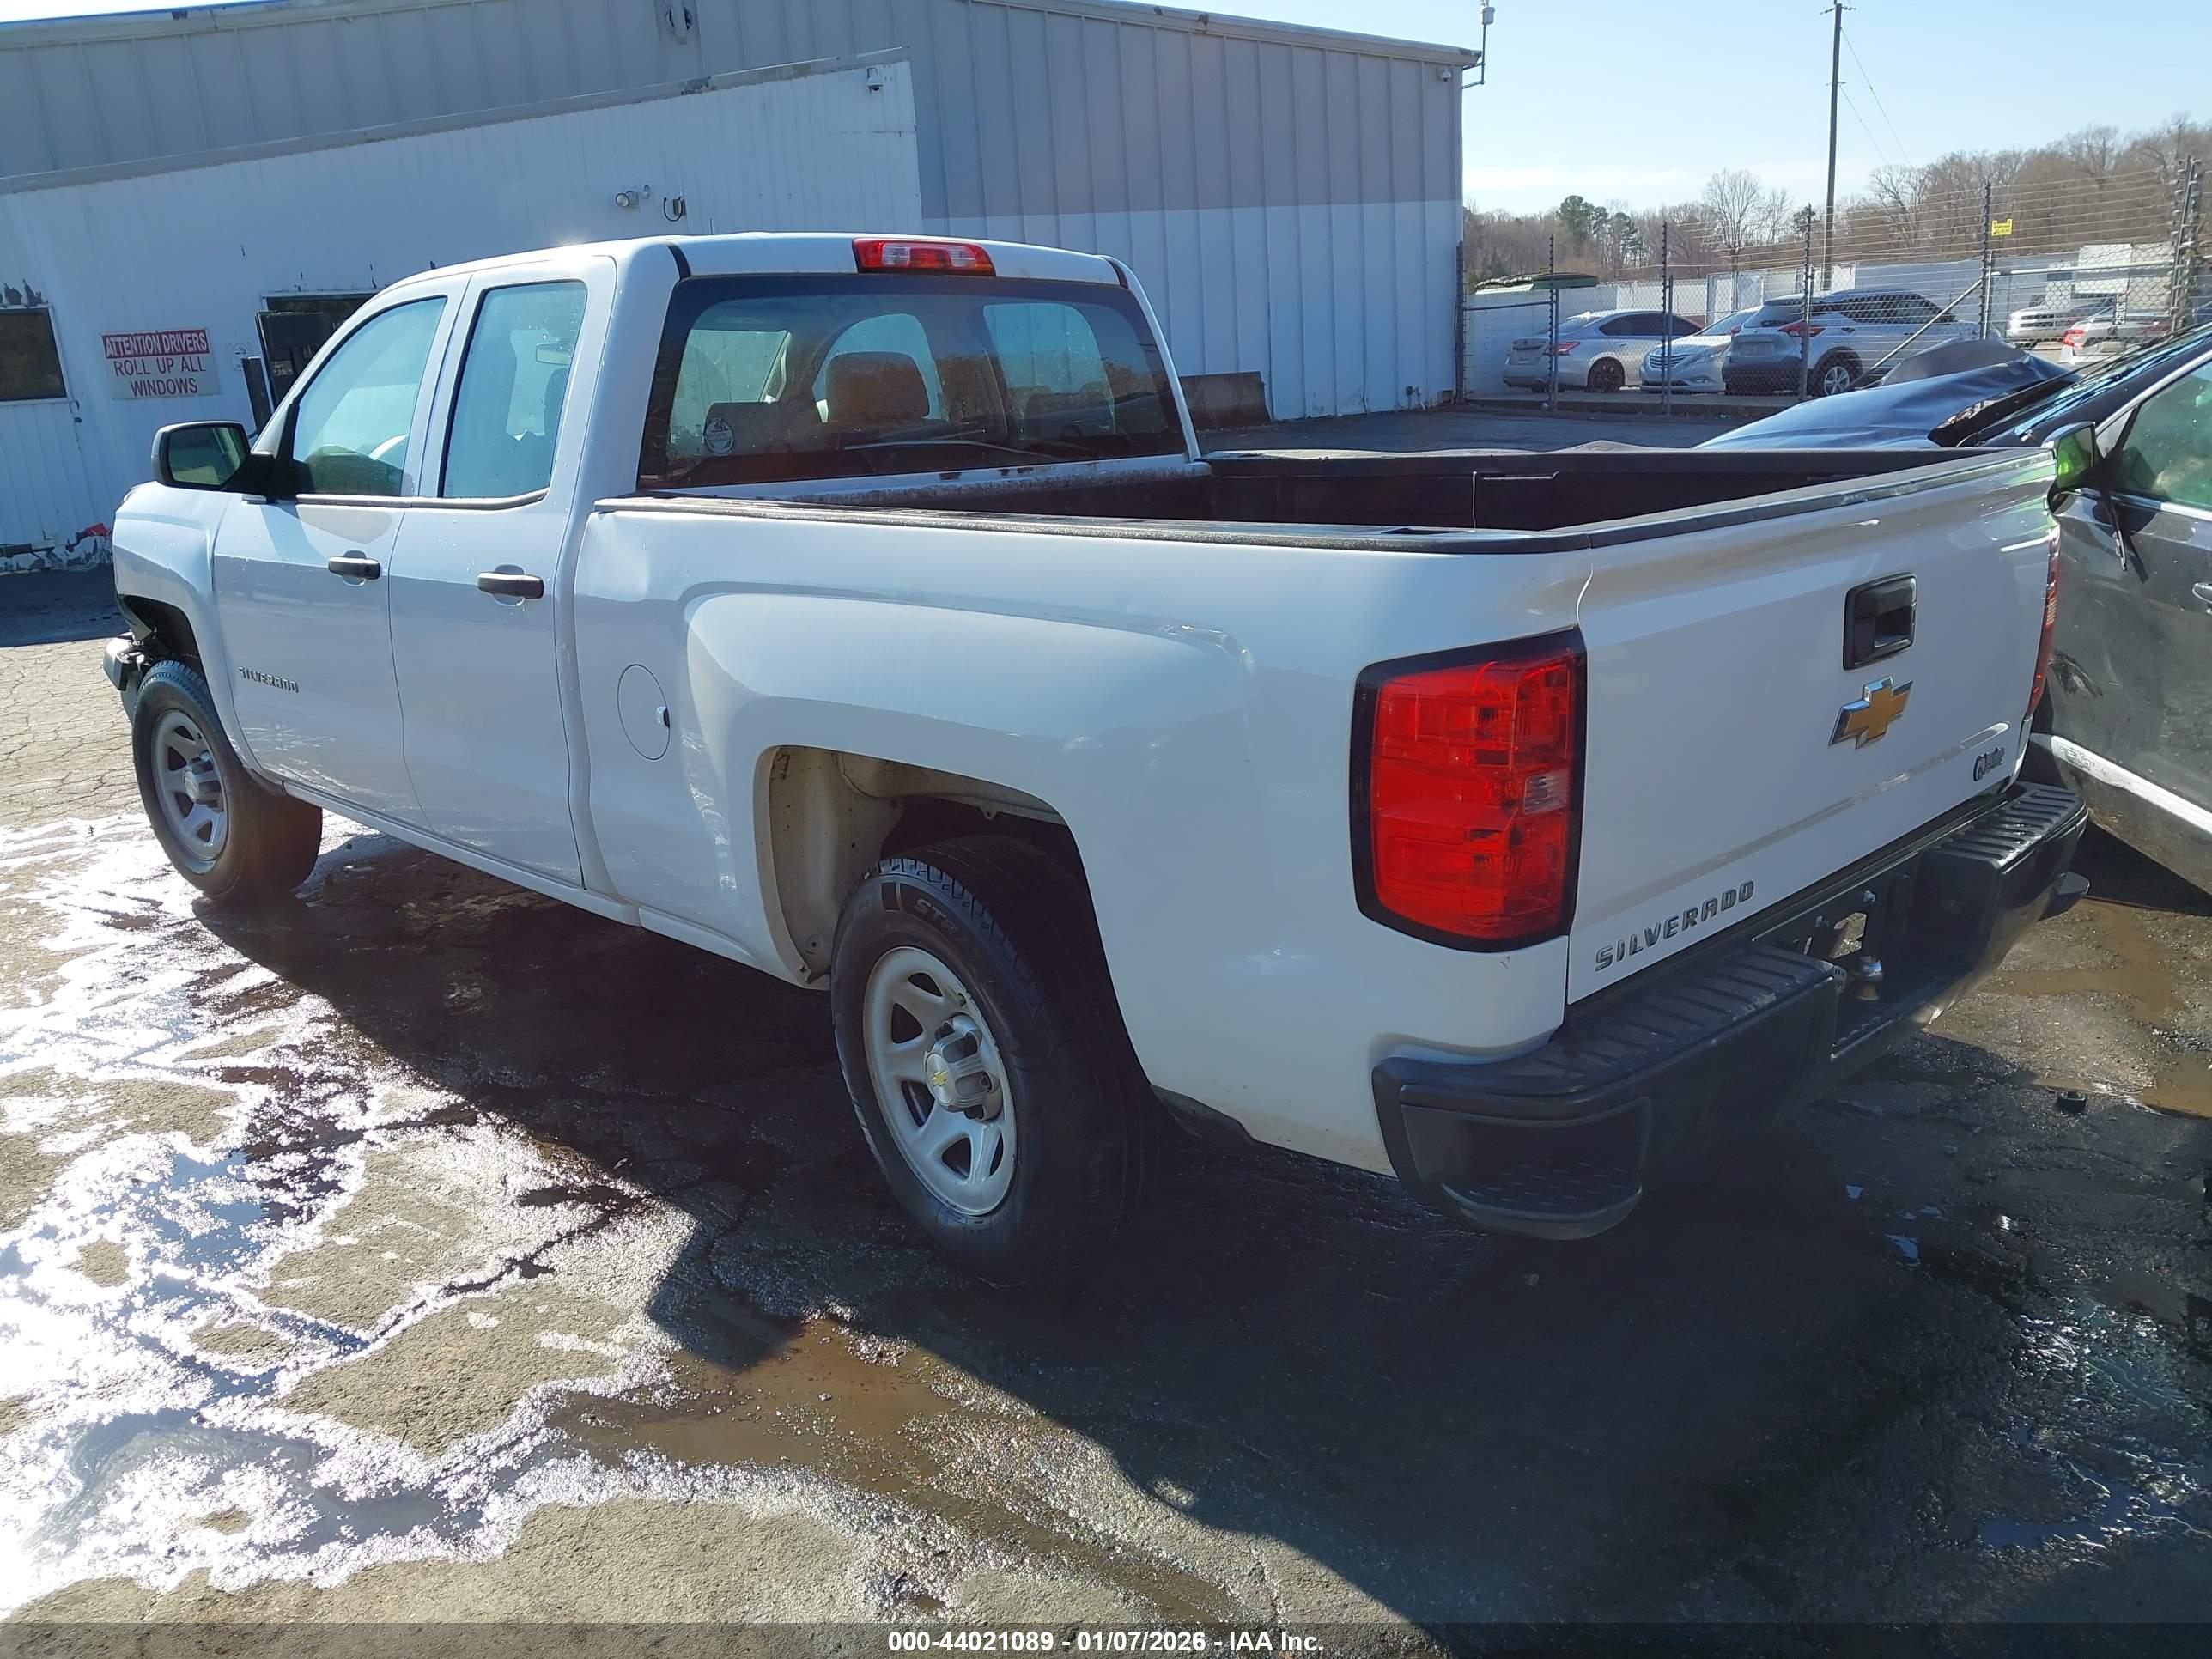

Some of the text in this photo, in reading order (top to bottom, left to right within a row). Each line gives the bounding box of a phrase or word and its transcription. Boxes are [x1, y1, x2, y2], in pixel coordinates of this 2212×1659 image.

[106, 331, 208, 356] ATTENTION DRIVERS
[113, 356, 207, 376] ROLL UP ALL
[130, 377, 198, 397] WINDOWS
[1595, 880, 1755, 972] SILVERADO
